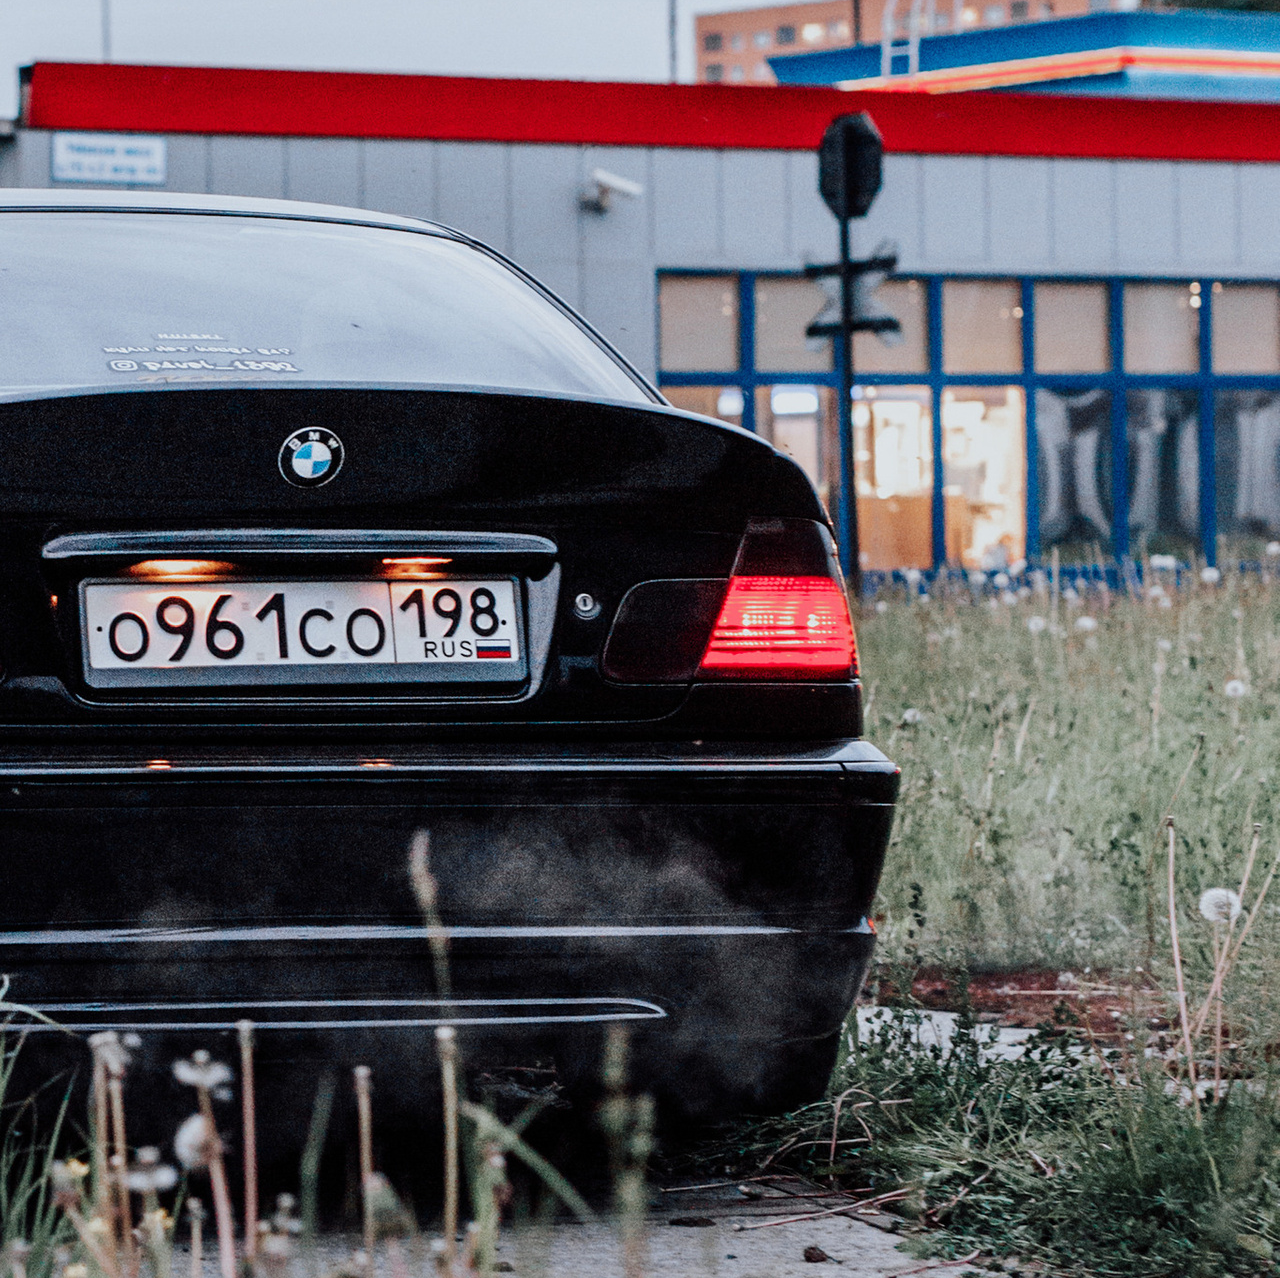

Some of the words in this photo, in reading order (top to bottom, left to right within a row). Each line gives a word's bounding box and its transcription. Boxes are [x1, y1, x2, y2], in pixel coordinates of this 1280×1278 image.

[287, 430, 340, 451] BMW
[398, 587, 500, 639] 198
[423, 640, 474, 660] RUS
